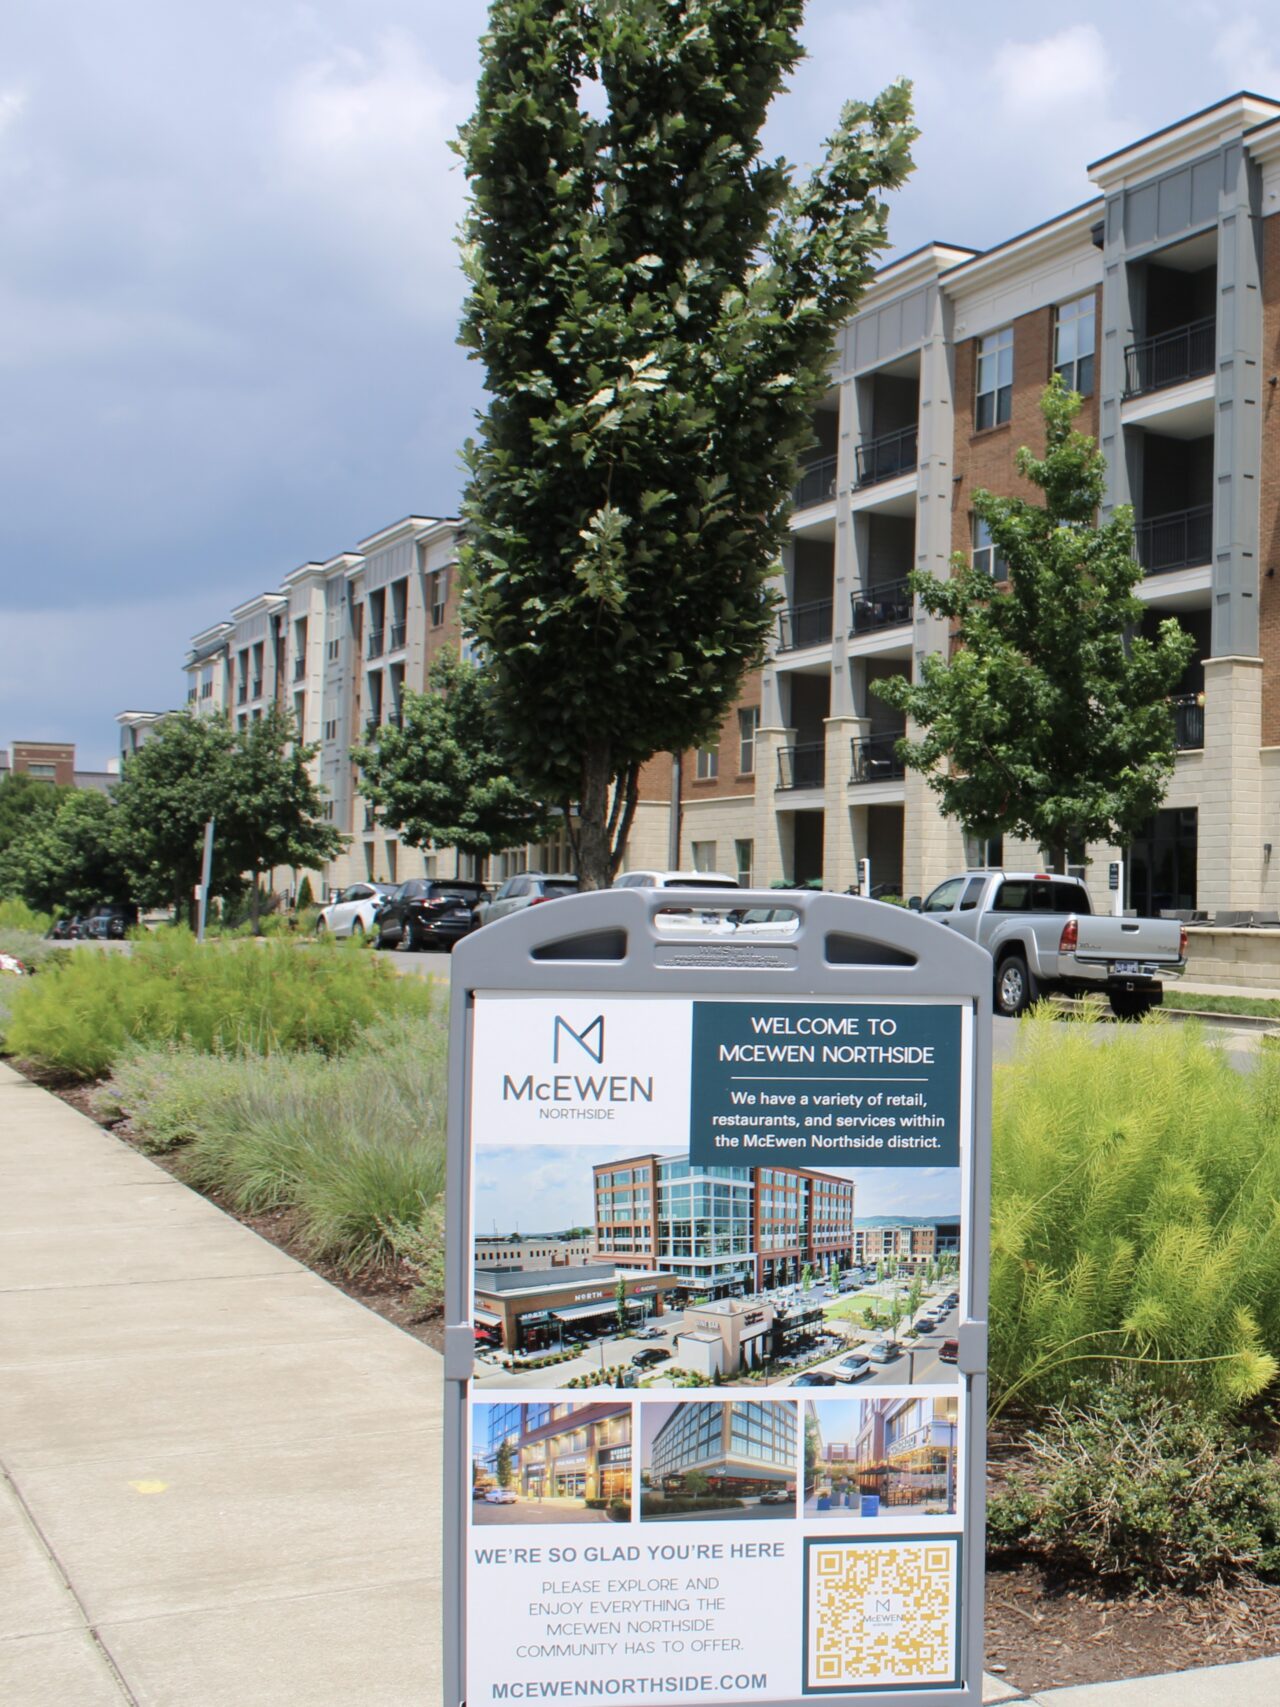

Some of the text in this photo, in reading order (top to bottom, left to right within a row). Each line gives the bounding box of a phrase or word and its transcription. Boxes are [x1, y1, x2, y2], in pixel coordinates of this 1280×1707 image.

[751, 1016, 897, 1036] WELCOME TO
[719, 1044, 935, 1064] MCEWEN NORTHSIDE
[503, 1074, 653, 1102] McEWEN
[730, 1091, 928, 1109] We have a variety of retail,
[539, 1108, 615, 1120] NORTHSIDE
[712, 1113, 945, 1128] restaurants, and services within
[714, 1134, 941, 1148] the McEwen Northside district.
[474, 1542, 785, 1565] WE'RE SO GLAD YOU'RE HERE
[542, 1576, 720, 1595] PLEASE EXPLORE AND
[529, 1597, 726, 1616] ENJOY EVERYTHING THE
[546, 1618, 715, 1636] MCEWEN NORTHSIDE
[516, 1638, 744, 1658] COMMUNITY HAS TO OFFER.
[492, 1674, 768, 1699] MCEWENNORTHSIDE.COM
